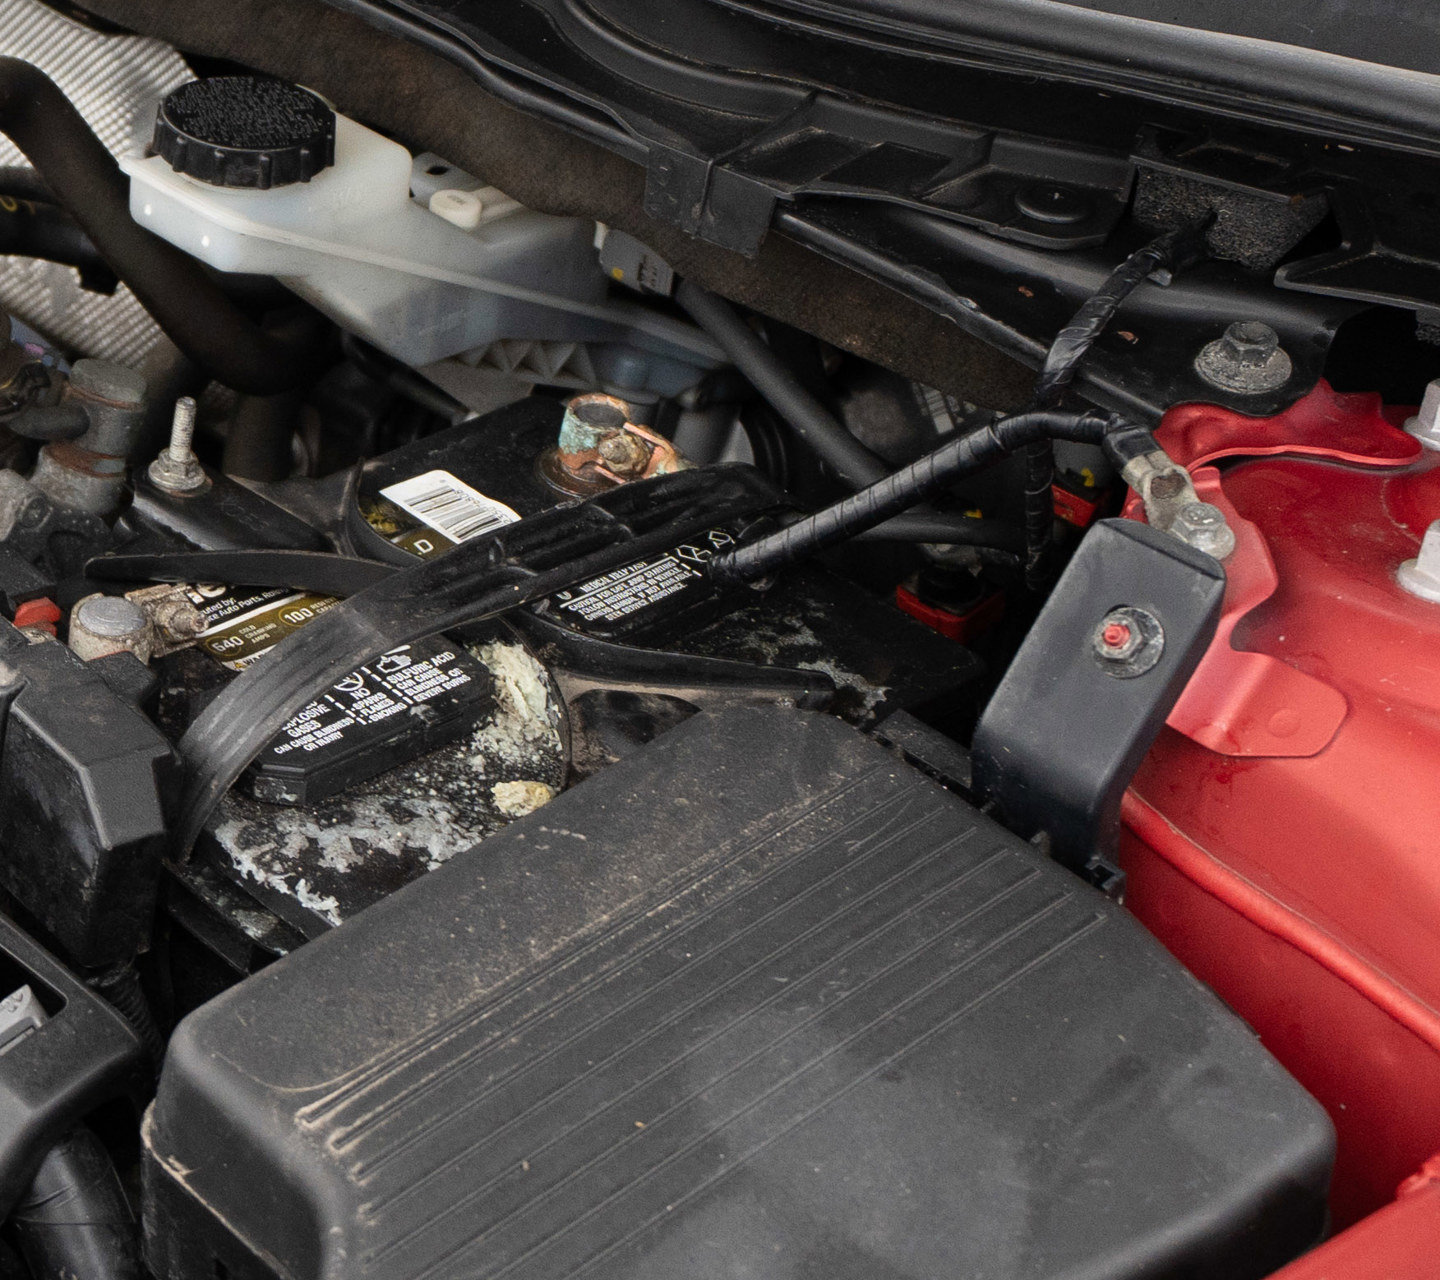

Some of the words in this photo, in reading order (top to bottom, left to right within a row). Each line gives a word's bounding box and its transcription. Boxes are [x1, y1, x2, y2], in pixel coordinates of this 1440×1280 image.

[219, 606, 239, 618] Auto
[284, 607, 314, 624] 100
[239, 624, 256, 634] COLD
[244, 623, 277, 639] CRANKING
[212, 636, 244, 652] 640
[251, 634, 270, 644] AMPS
[387, 660, 433, 684] SULFURIC
[432, 651, 456, 669] ACID
[397, 677, 415, 690] CAN
[415, 668, 441, 684] CAUSE
[404, 675, 450, 696] BLINDNESS
[351, 688, 370, 700] NO
[361, 699, 395, 717] FLAMES
[371, 702, 407, 723] SMOKING
[274, 740, 291, 755] CAN
[290, 732, 316, 749] CAUSE
[316, 717, 356, 740] BLINDNESS
[287, 720, 322, 739] GASES
[303, 740, 317, 752] OR
